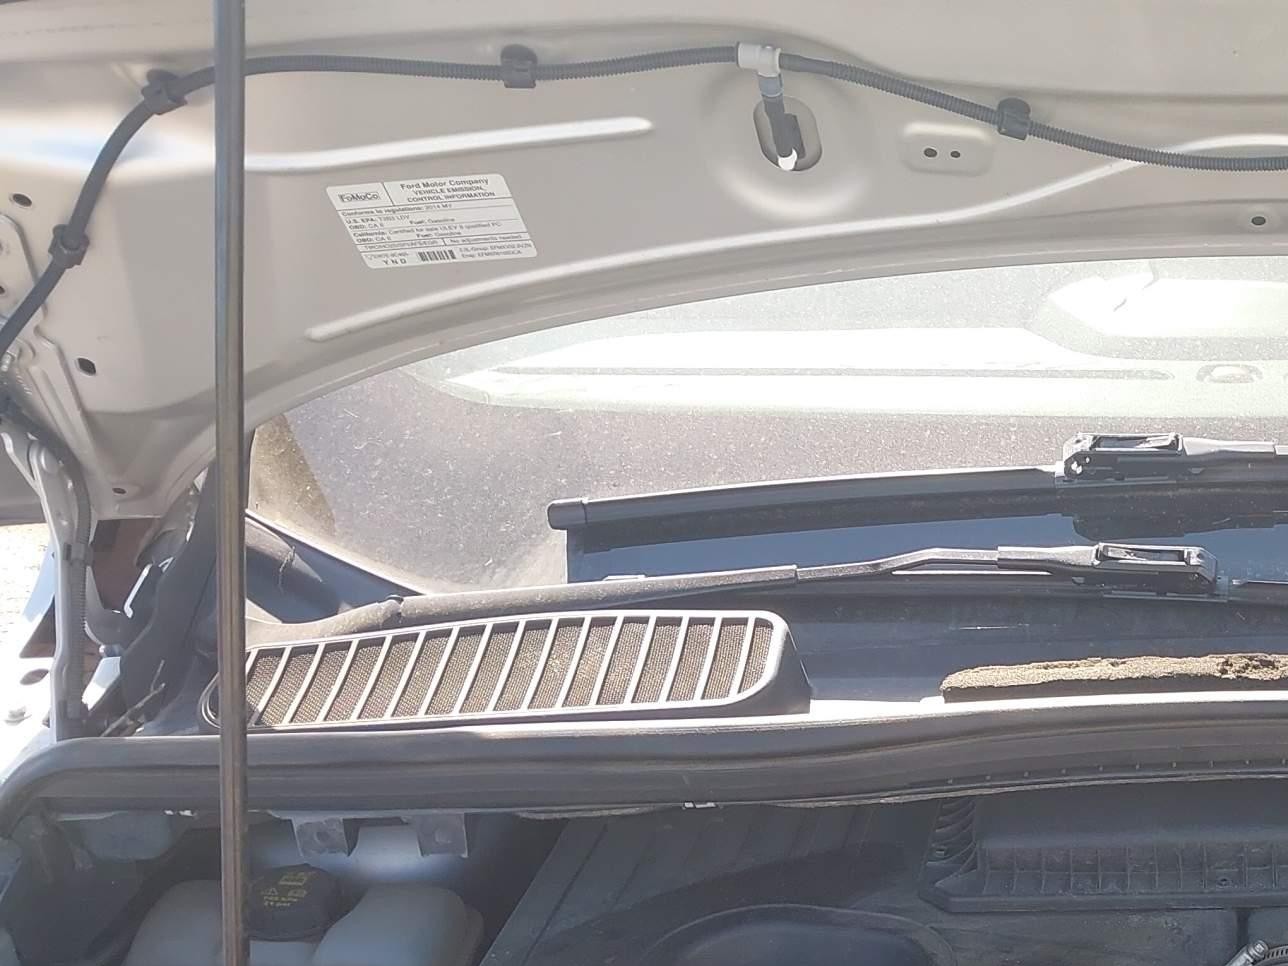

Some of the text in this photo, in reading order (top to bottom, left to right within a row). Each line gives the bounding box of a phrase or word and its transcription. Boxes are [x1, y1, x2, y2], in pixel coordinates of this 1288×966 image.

[399, 176, 490, 190] Ford Motor Company
[443, 191, 495, 200] INFORMATION
